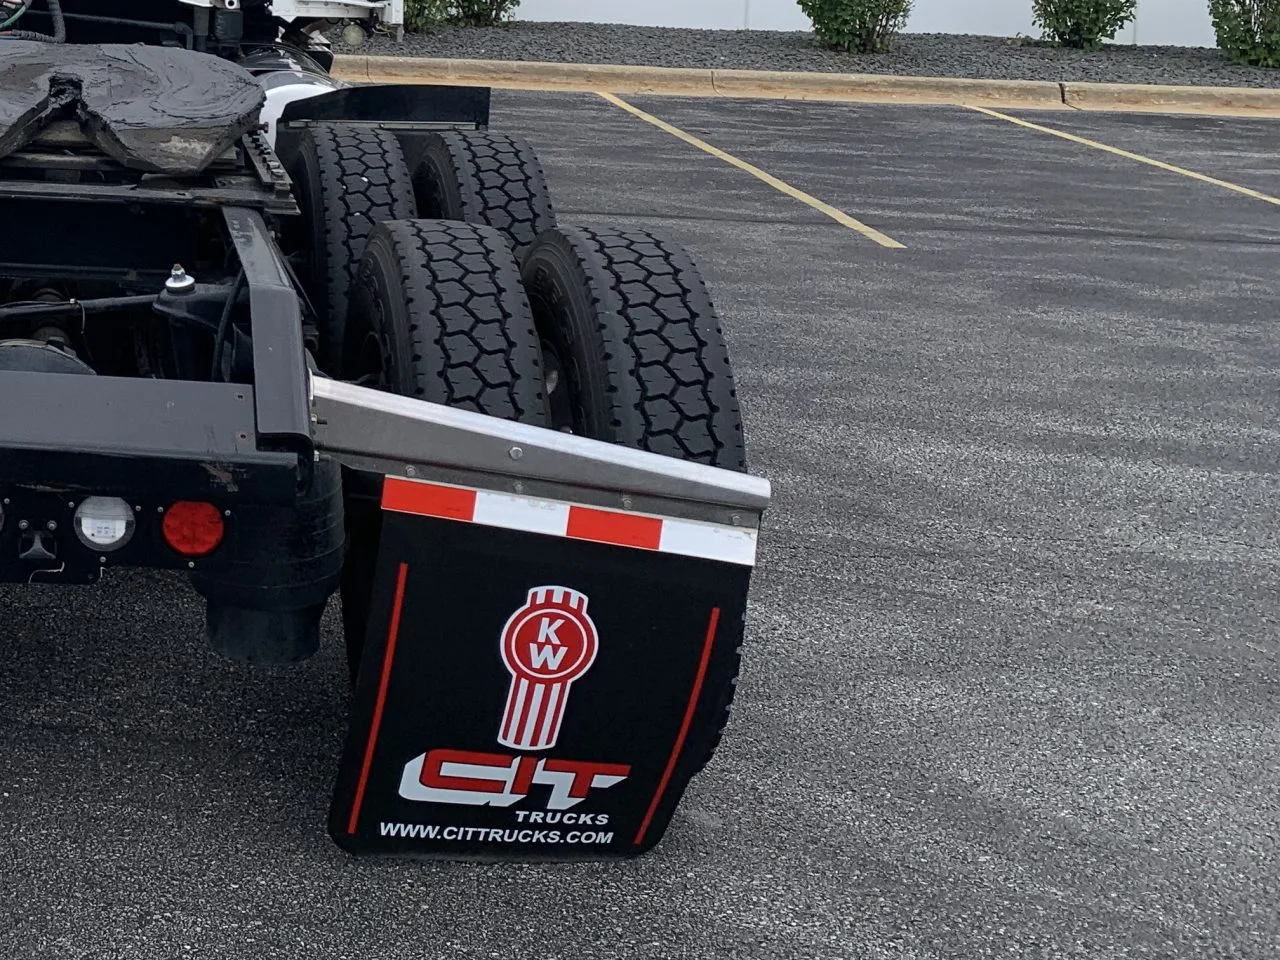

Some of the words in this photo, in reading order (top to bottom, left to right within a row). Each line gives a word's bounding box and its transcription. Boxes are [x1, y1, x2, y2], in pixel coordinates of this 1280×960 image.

[537, 617, 565, 645] K
[529, 643, 568, 670] W
[399, 749, 632, 810] CIT
[515, 811, 609, 825] TRUCKS
[380, 822, 613, 844] WWW.CITTRUCKS.COM
